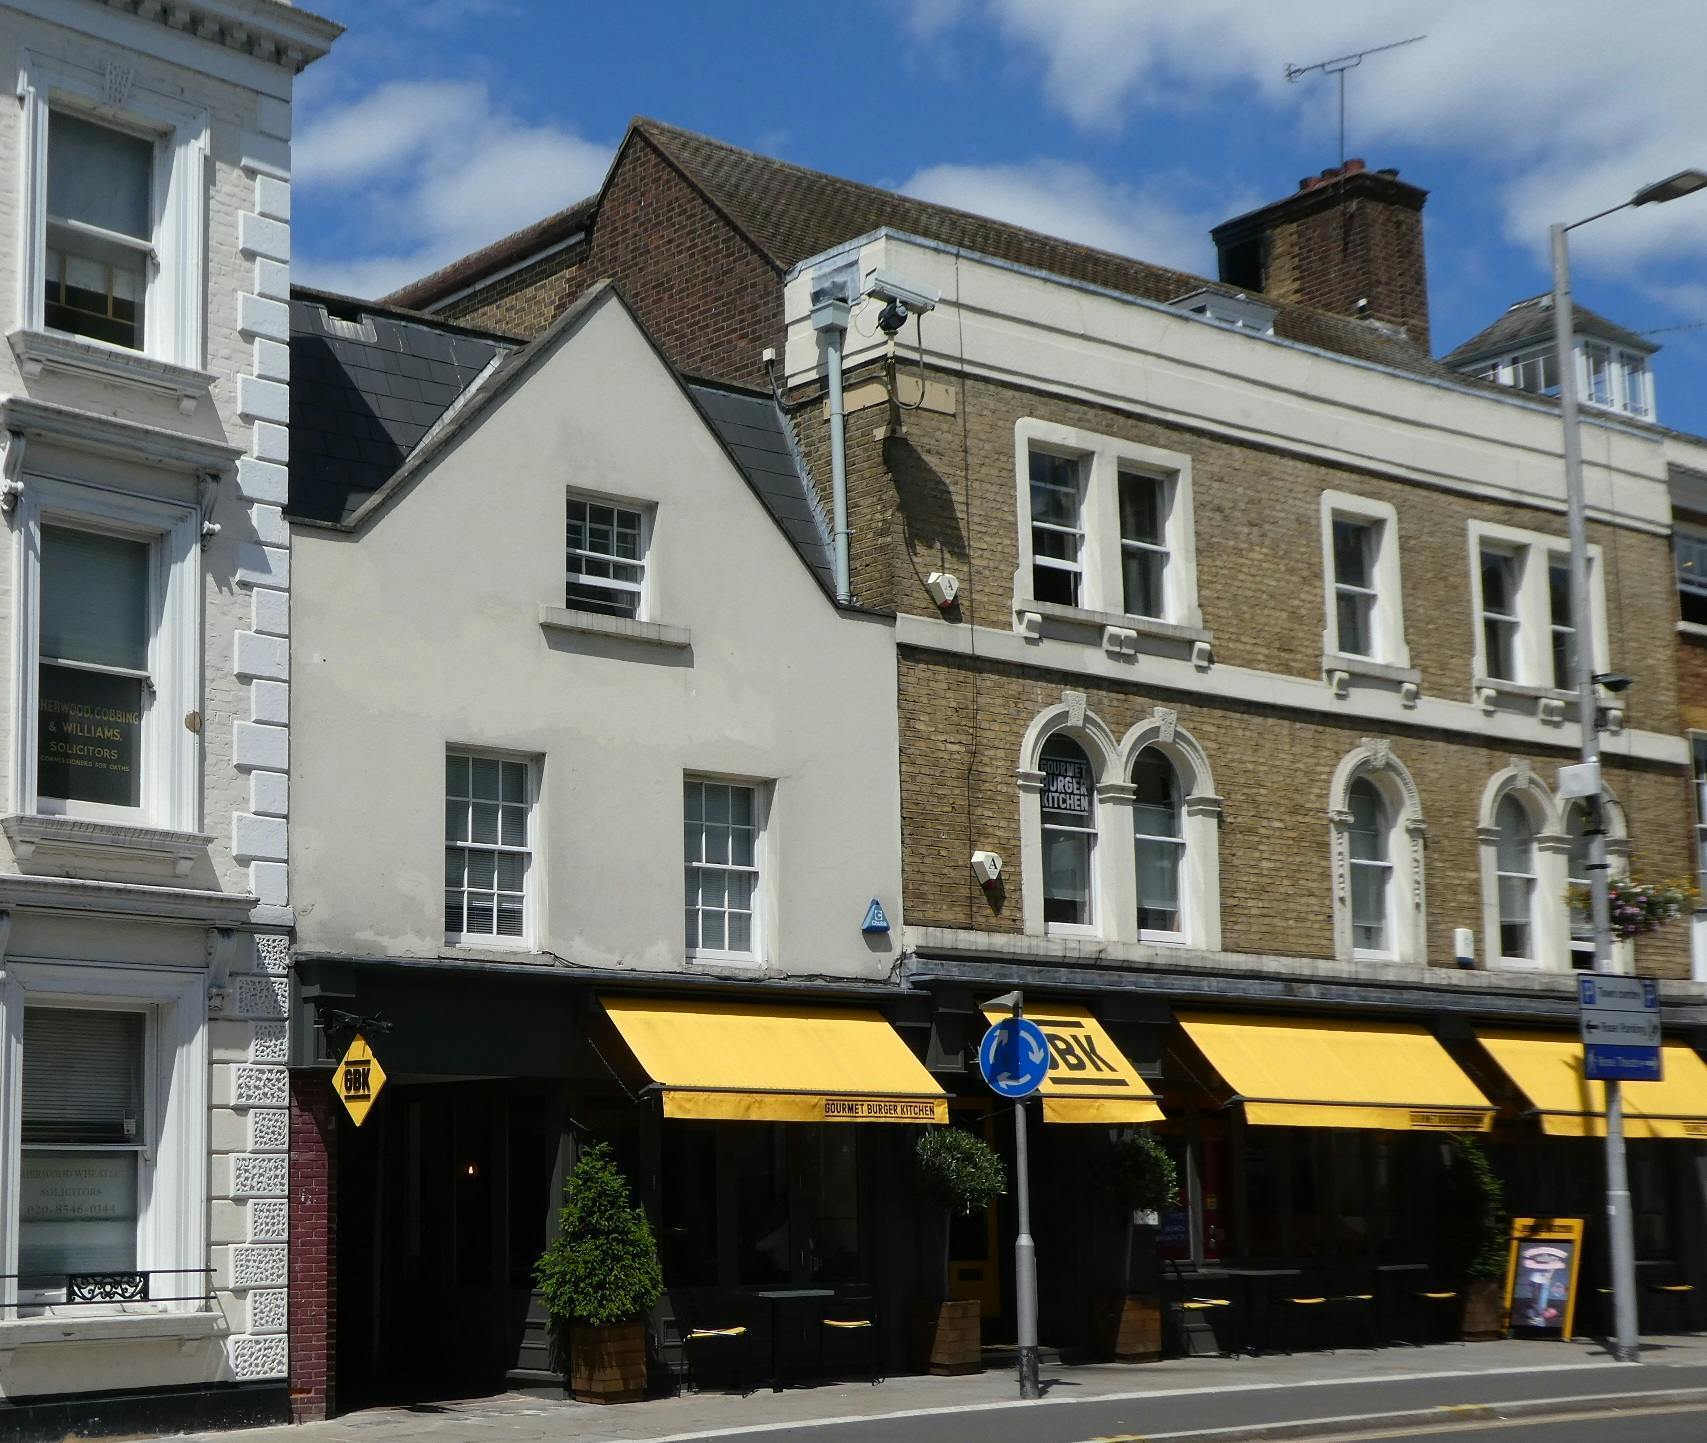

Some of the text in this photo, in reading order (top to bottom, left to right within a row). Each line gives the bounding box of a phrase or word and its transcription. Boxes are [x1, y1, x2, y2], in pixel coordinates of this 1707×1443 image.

[50, 741, 119, 760] SOLICITORS
[1041, 760, 1089, 779] GOURMET
[1042, 775, 1088, 795] BURGER
[1042, 791, 1089, 811] KITCHEN
[345, 1067, 371, 1094] GBK
[824, 1102, 935, 1116] GOURMET BURGER KITCHEN
